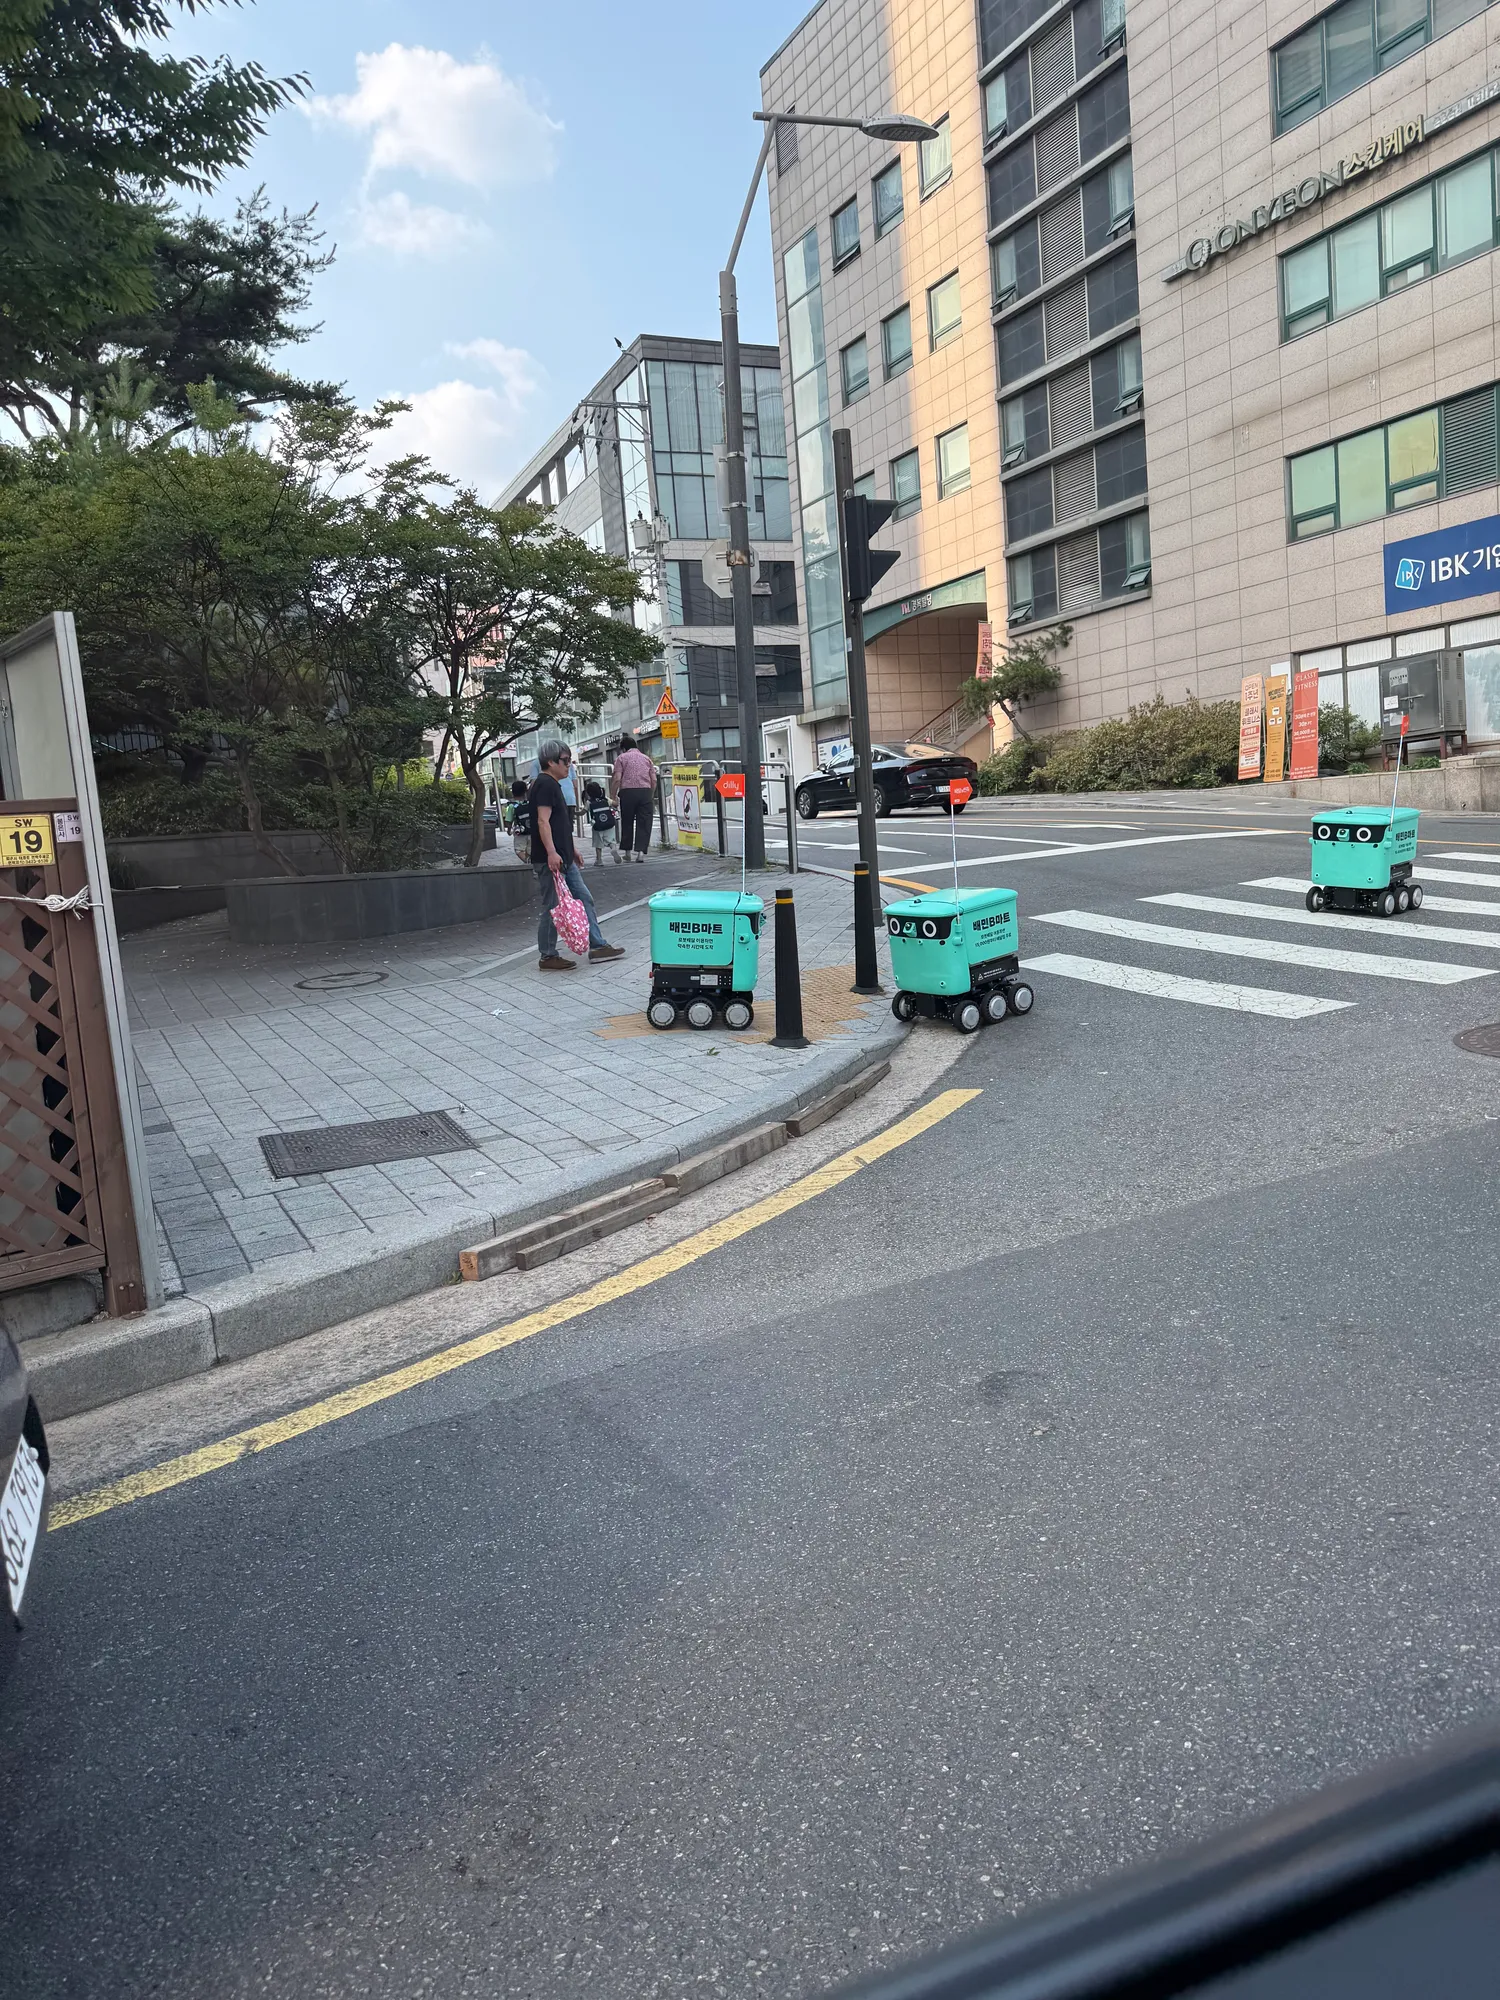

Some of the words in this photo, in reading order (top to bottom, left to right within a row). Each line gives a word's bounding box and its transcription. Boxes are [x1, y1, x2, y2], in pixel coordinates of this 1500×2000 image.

[1431, 552, 1470, 583] IBK
[1295, 680, 1317, 691] FITNESS
[723, 780, 739, 790] dilly
[15, 819, 33, 827] SW
[70, 826, 80, 834] 19
[9, 830, 43, 853] 19
[973, 912, 1010, 931] 배민B마트
[669, 922, 723, 934] 배민B마트
